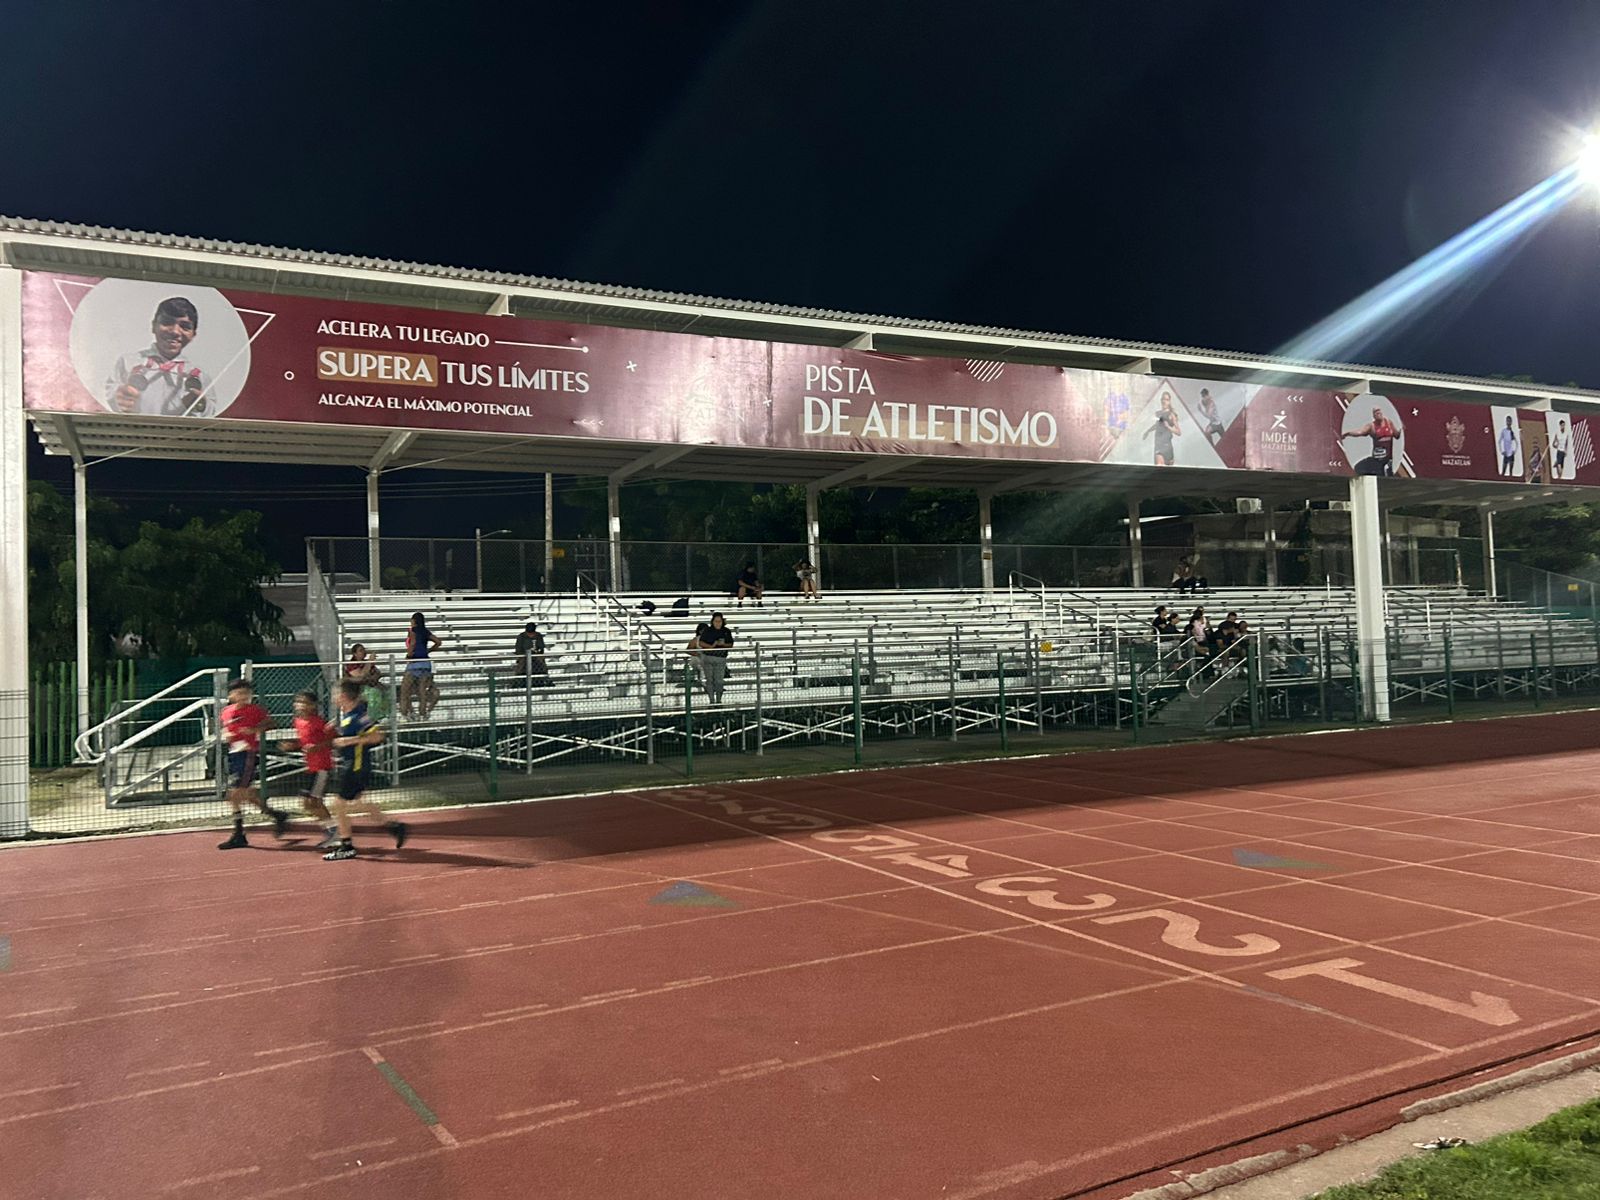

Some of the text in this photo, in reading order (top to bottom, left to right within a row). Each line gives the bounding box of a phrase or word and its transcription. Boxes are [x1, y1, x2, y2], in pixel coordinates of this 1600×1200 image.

[317, 319, 490, 347] ACELERA TU LEGADO
[319, 350, 590, 394] SUPERA TUS LÍMITES
[805, 364, 876, 395] PISTA
[318, 393, 533, 418] ALCANZA EL MÁXIMO POTENCIAL
[803, 396, 1058, 448] DE ATLETISMO
[1261, 431, 1297, 444] IMDEM
[810, 829, 920, 852] 5
[872, 851, 974, 878] 4
[974, 876, 1117, 911] 3
[1090, 909, 1281, 957] 2
[1265, 957, 1521, 1027] 1
